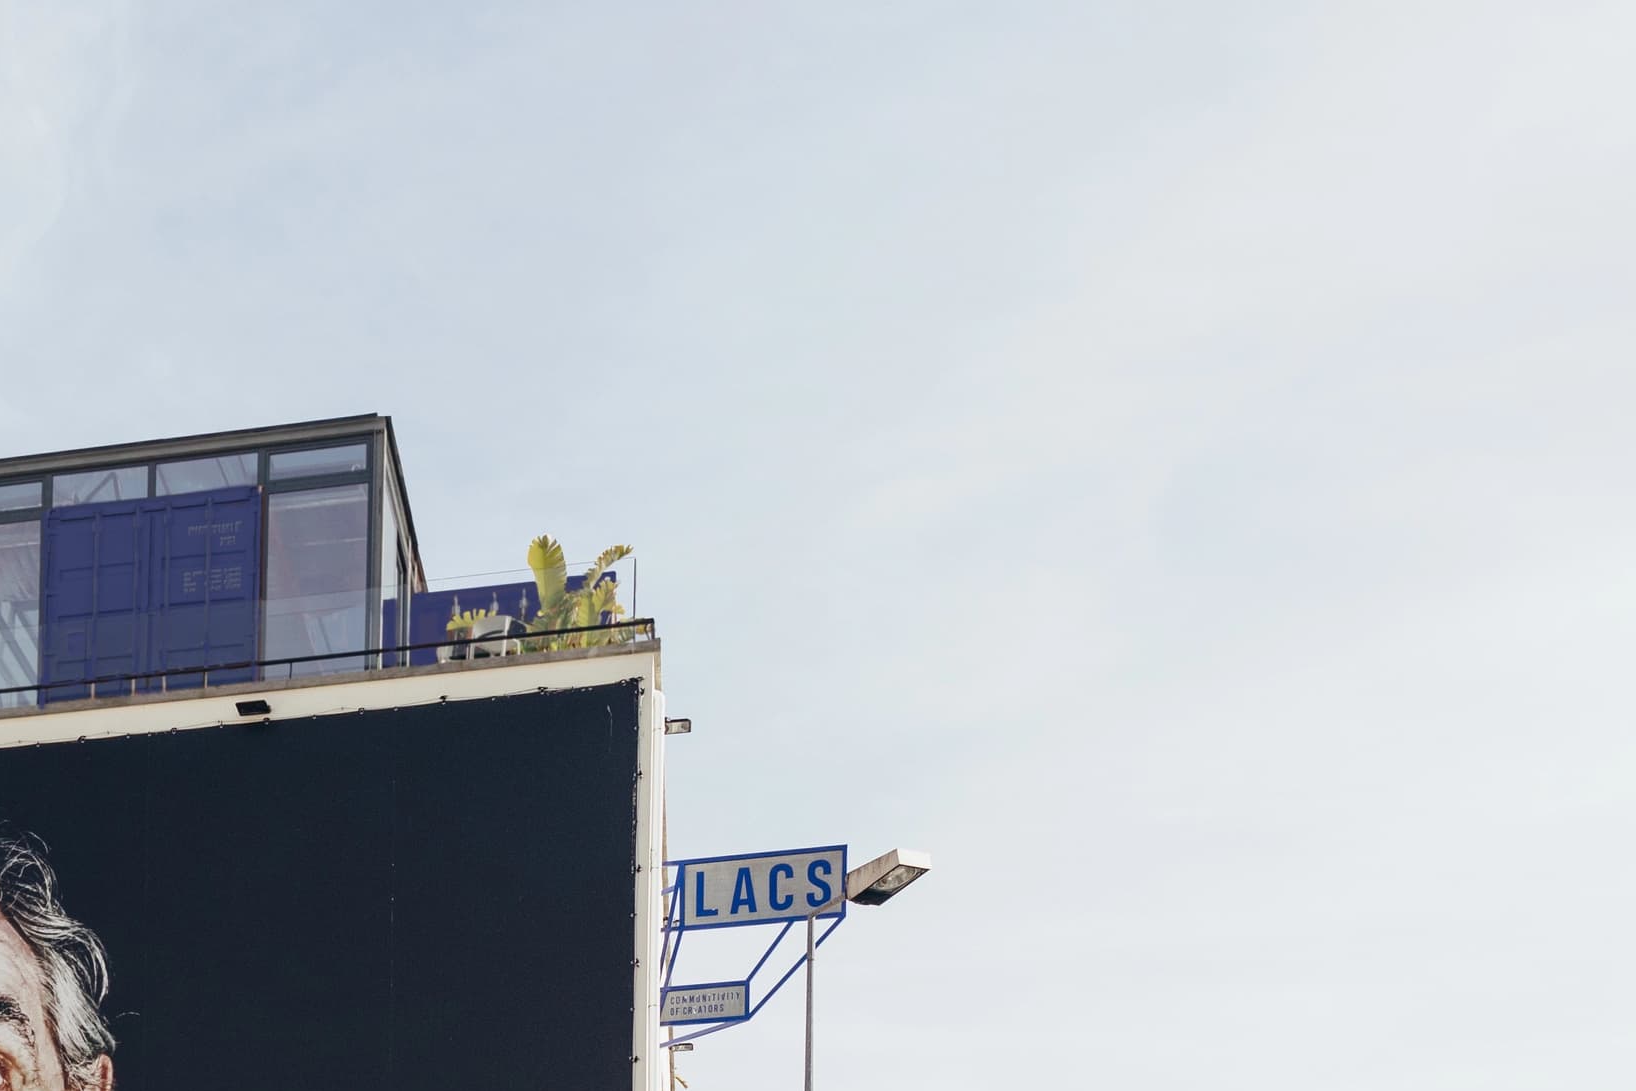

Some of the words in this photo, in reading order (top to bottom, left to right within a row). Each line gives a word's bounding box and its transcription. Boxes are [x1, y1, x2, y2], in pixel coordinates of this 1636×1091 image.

[695, 859, 832, 917] LACS
[670, 1007, 681, 1016] OF
[682, 1004, 724, 1015] CRATORS
